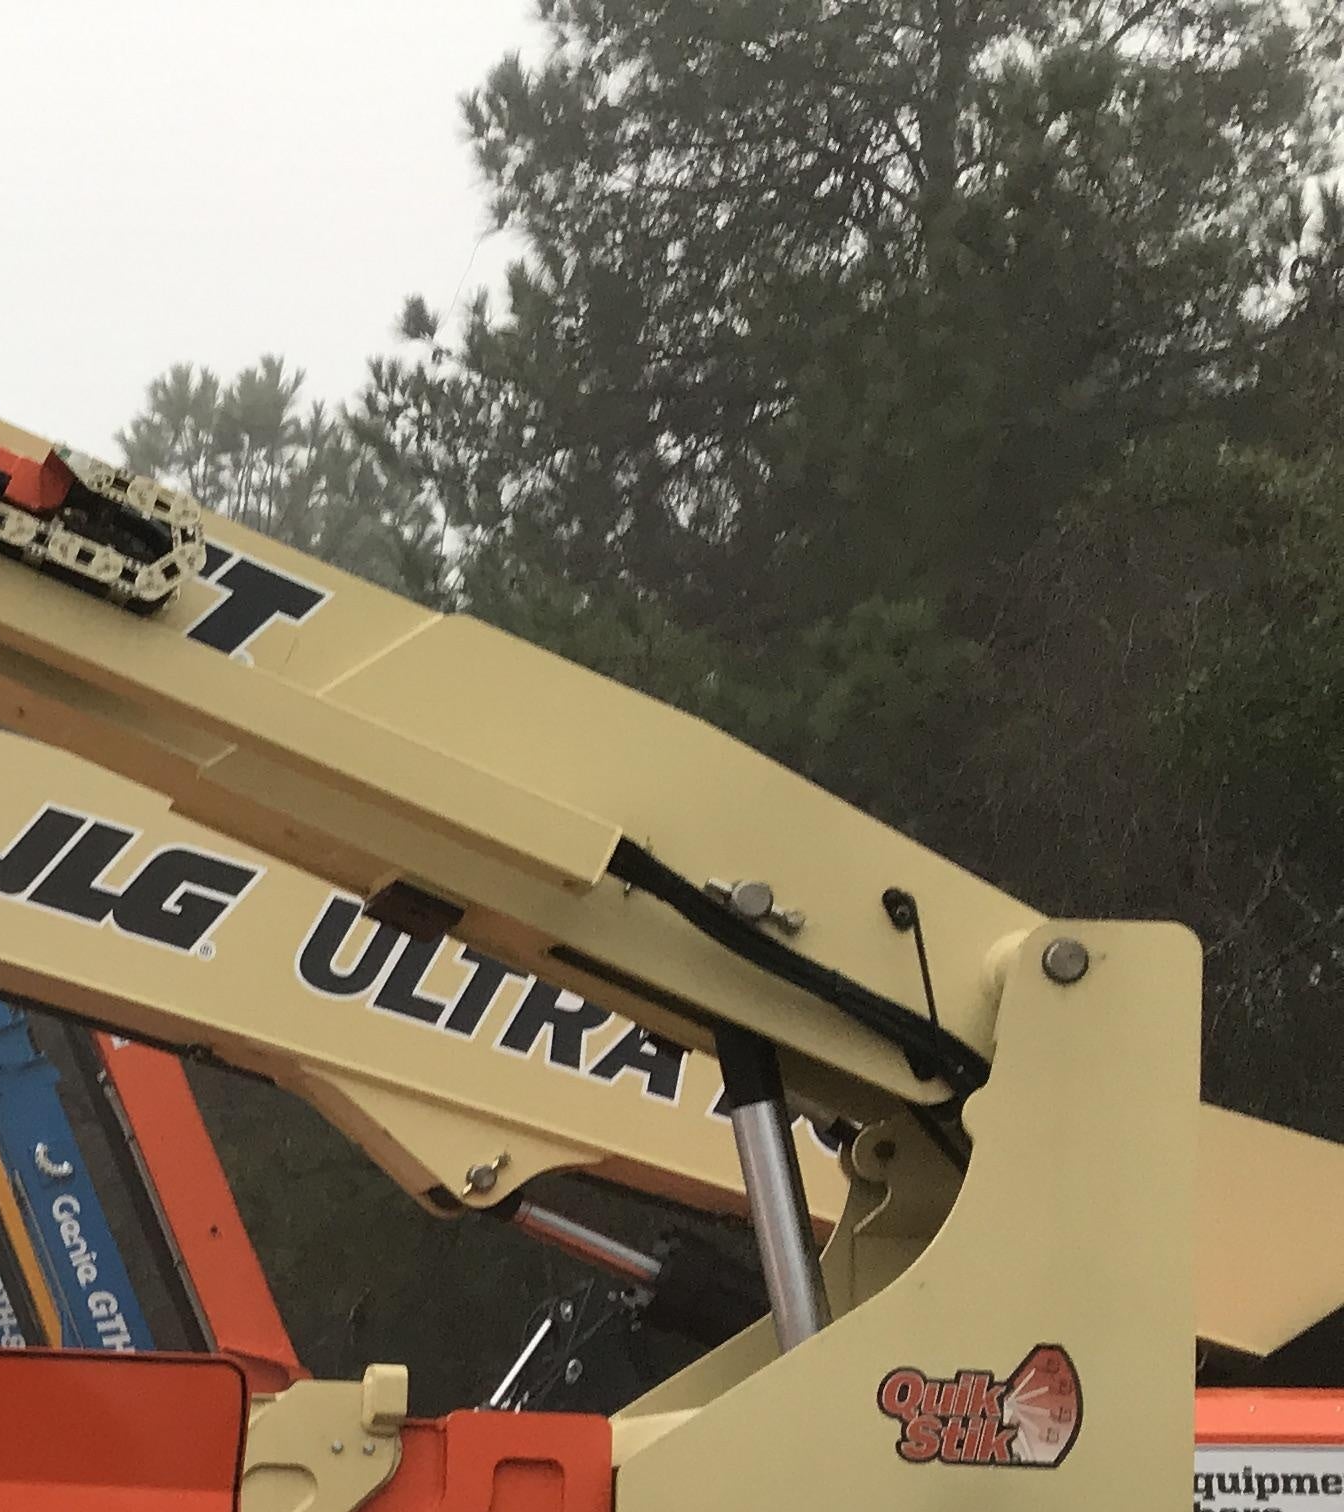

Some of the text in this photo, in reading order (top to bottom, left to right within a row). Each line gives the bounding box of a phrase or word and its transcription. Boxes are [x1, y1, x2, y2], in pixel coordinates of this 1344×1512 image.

[296, 890, 685, 1106] ULTRA
[52, 1193, 136, 1354] Genie GTH
[899, 1413, 1015, 1462] Stik
[1193, 1466, 1344, 1501] quipme
